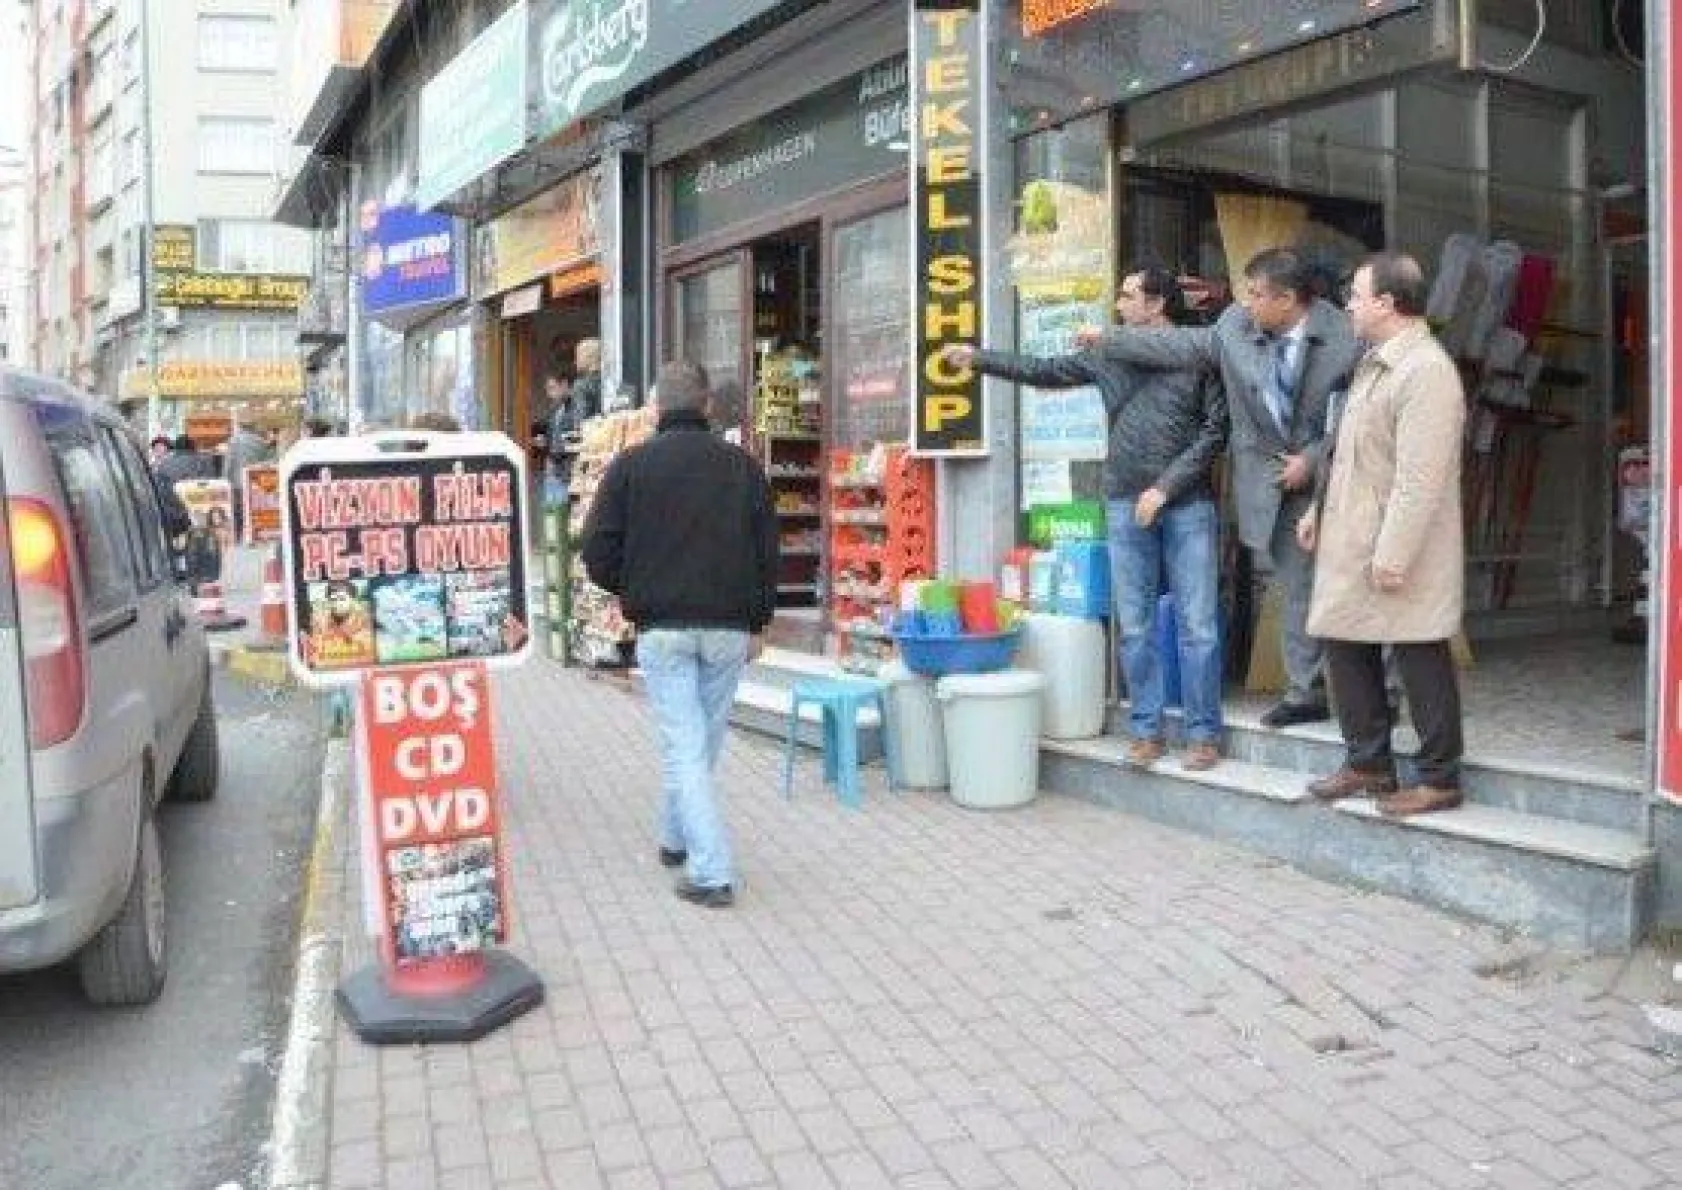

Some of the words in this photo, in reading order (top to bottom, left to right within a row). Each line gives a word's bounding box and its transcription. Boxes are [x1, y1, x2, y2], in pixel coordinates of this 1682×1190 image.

[543, 0, 648, 102] Carlsberg
[923, 9, 972, 229] TEKEL
[925, 254, 975, 432] SHOP
[294, 466, 421, 529] VİZYON
[433, 460, 514, 520] FİLM
[300, 525, 407, 582] PC-PS
[415, 522, 512, 576] OYUN
[373, 669, 480, 730] BOŞ
[393, 732, 466, 780] CD
[381, 787, 490, 840] DVD
